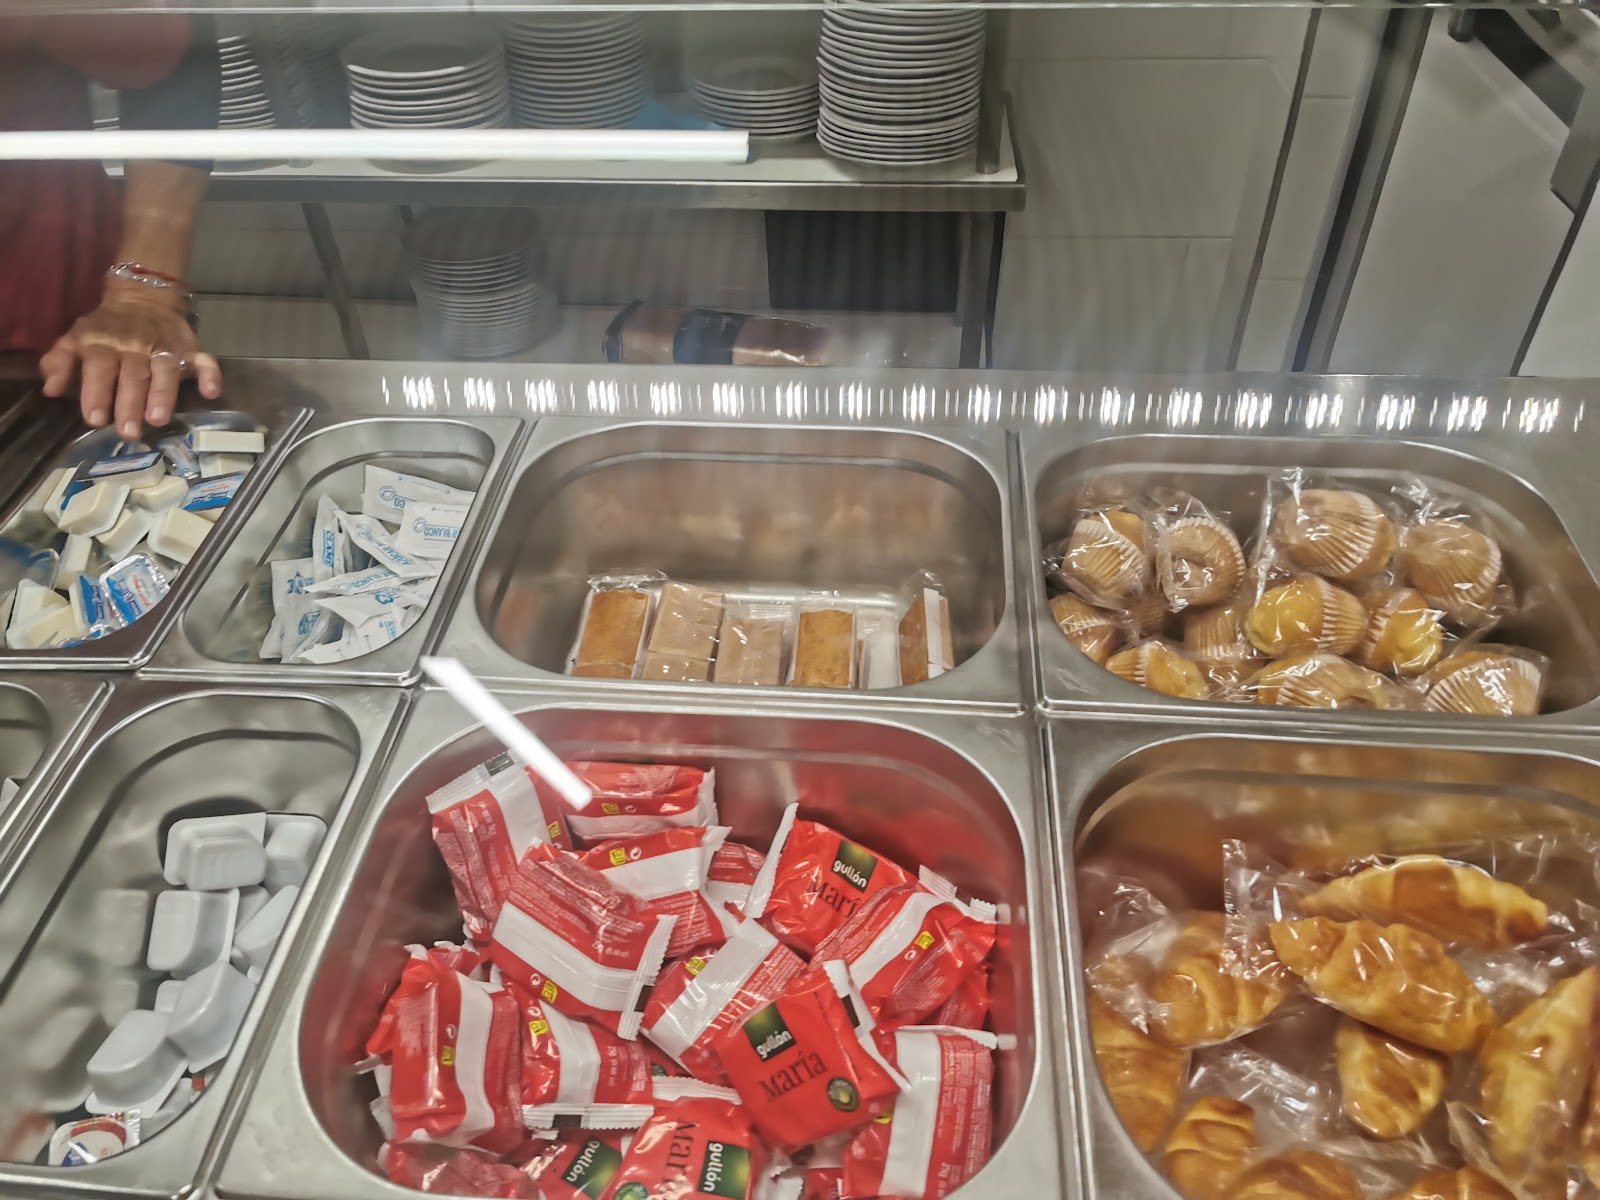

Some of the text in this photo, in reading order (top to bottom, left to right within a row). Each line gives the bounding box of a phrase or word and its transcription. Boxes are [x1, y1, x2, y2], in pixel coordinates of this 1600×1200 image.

[424, 527, 451, 538] BLANCO
[832, 859, 868, 889] gullón
[806, 874, 862, 918] Marí
[756, 1029, 794, 1060] gullón
[757, 1050, 829, 1103] María
[703, 1142, 724, 1193] gullón
